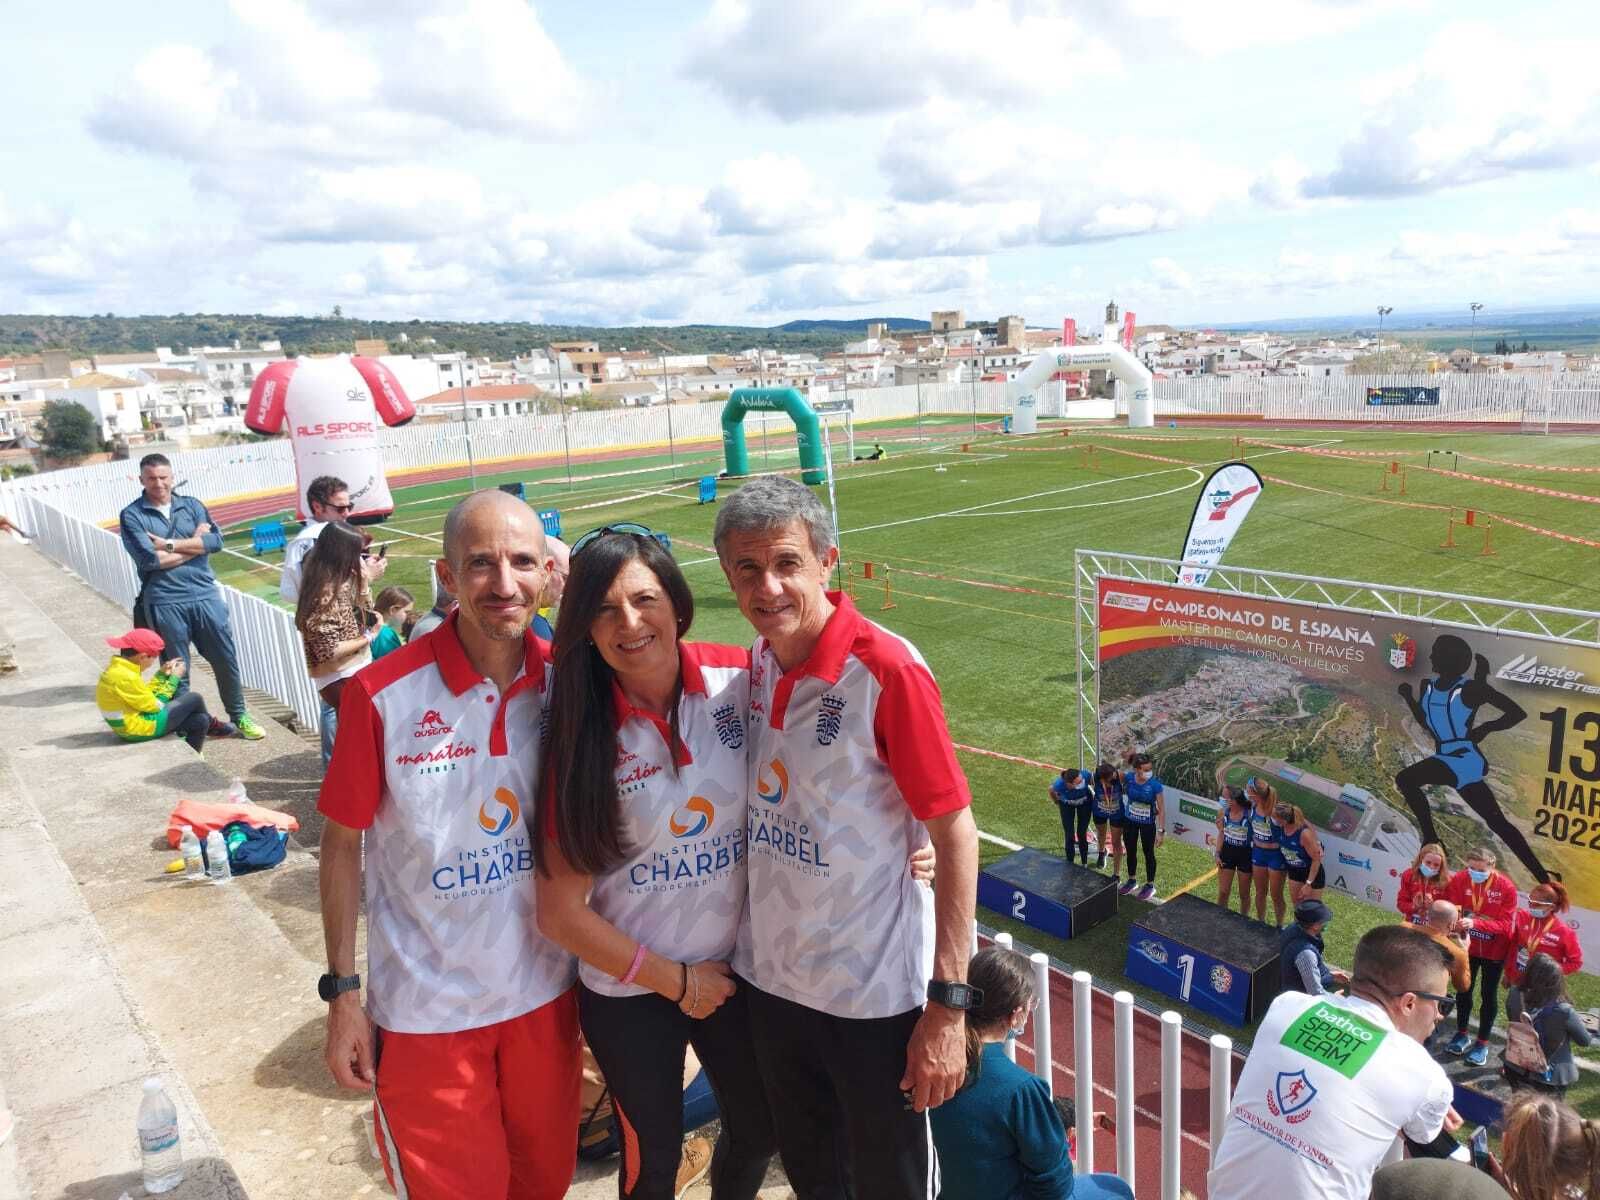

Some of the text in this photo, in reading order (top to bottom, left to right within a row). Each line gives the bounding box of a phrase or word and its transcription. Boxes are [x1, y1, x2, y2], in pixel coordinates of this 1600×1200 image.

[297, 424, 325, 437] ALS
[1152, 598, 1265, 625] CAMPEONATO
[1271, 615, 1293, 633] DE
[1300, 619, 1376, 647] ESPAÑA
[1160, 617, 1365, 662] MASTER DE CAMPO A TRAVÉS
[1247, 648, 1350, 674] HORNACHUELOS
[1532, 676, 1600, 696] ATLETIS
[396, 741, 477, 766] maratón
[1539, 706, 1600, 782] 13
[749, 805, 808, 835] NSTITUTO
[1533, 808, 1600, 850] 2022
[459, 838, 525, 862] INSTITU
[630, 840, 744, 886] CHARBE
[433, 850, 534, 890] CHARB
[1012, 891, 1026, 921] 2
[1177, 954, 1196, 1002] 1
[1303, 1017, 1367, 1052] SPORT
[1315, 1007, 1373, 1041] bathco
[1294, 1029, 1352, 1066] TEAM
